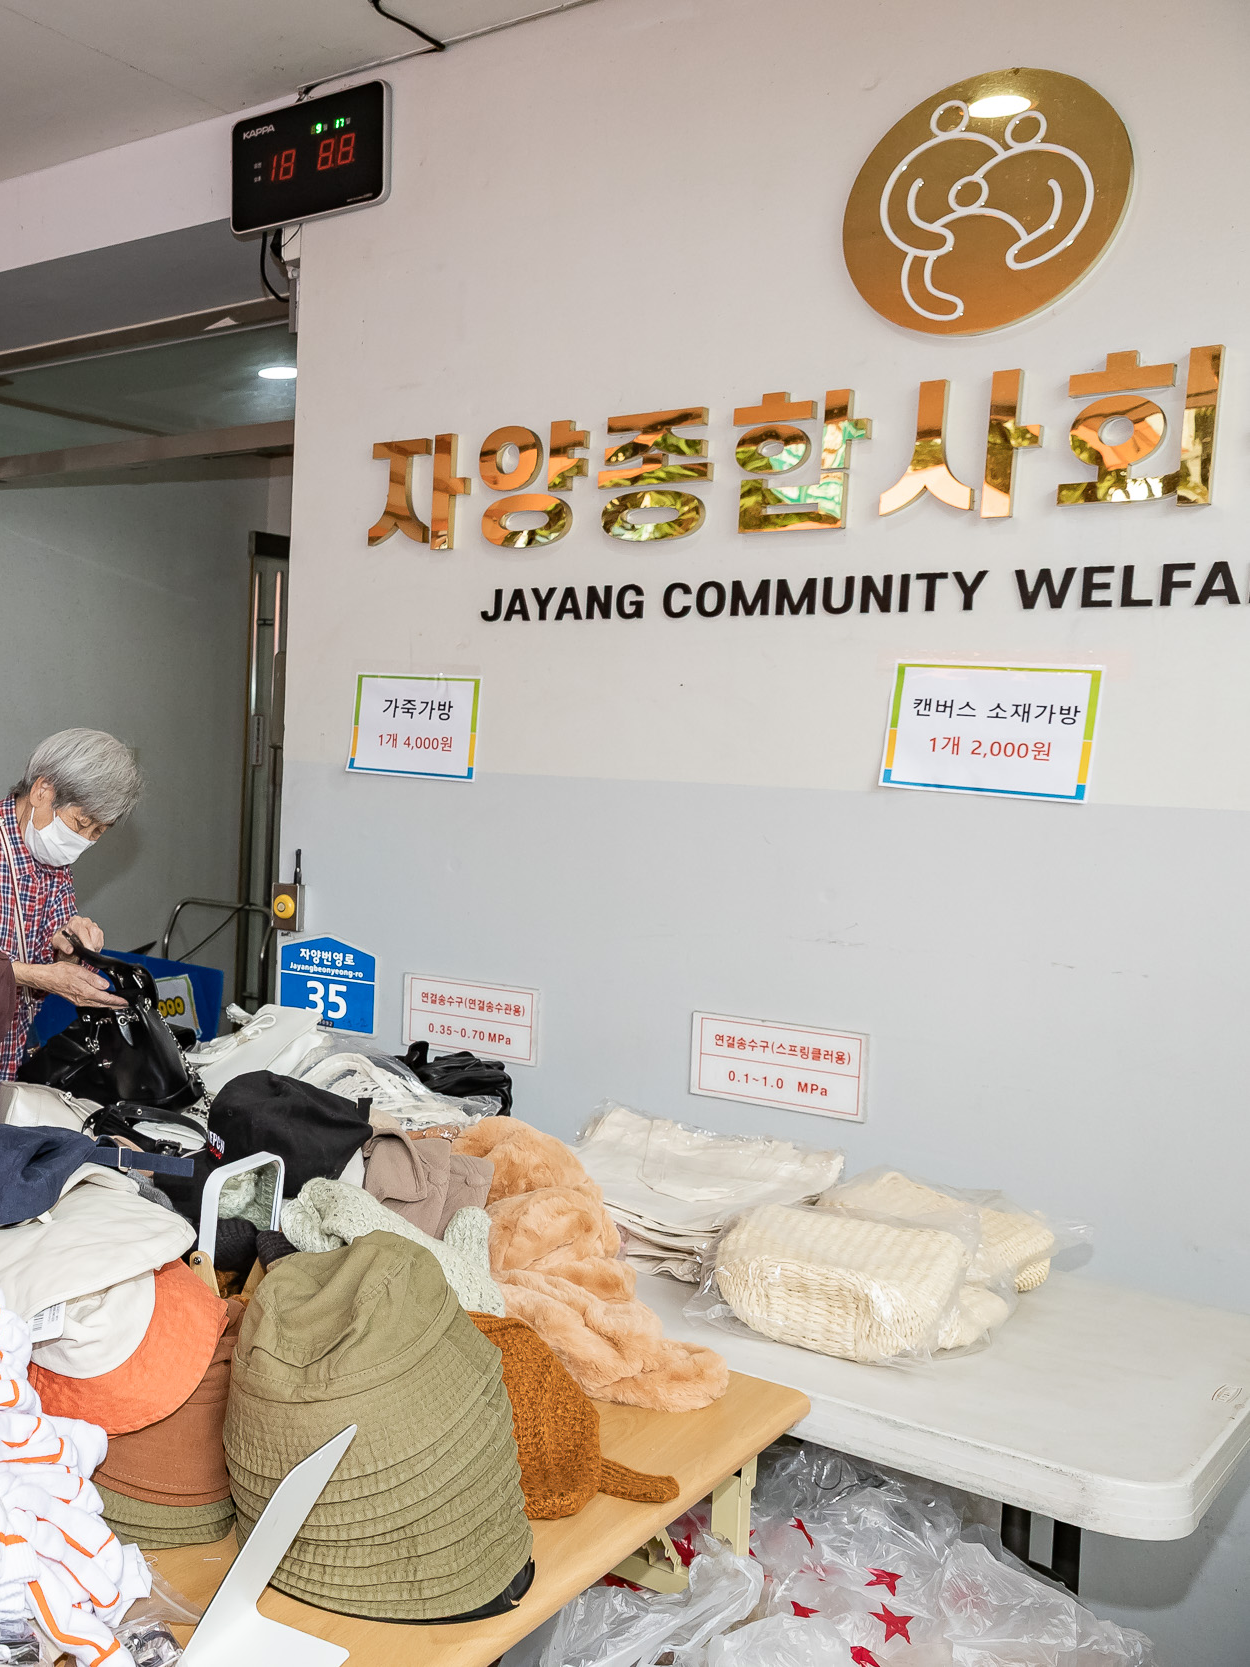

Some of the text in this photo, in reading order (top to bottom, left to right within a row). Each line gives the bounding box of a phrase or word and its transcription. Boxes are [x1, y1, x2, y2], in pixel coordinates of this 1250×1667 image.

[242, 124, 275, 140] KAPPA
[367, 344, 1225, 551] 자양종합사회
[480, 560, 1250, 622] JAYANG COMMUNITY WELFA
[382, 698, 454, 721] 가죽가방
[913, 698, 1081, 726] 캔버스 소재가방
[378, 733, 453, 752] 1개 4,000원
[929, 736, 1052, 762] 1개 2,000원
[289, 961, 363, 978] Jayangbeonyeong-ro
[299, 948, 355, 967] 자양번영로
[305, 980, 347, 1019] 35
[428, 1023, 511, 1046] 0.35~0.70 MPa
[728, 1070, 828, 1097] 0.1~1.0 MPa
